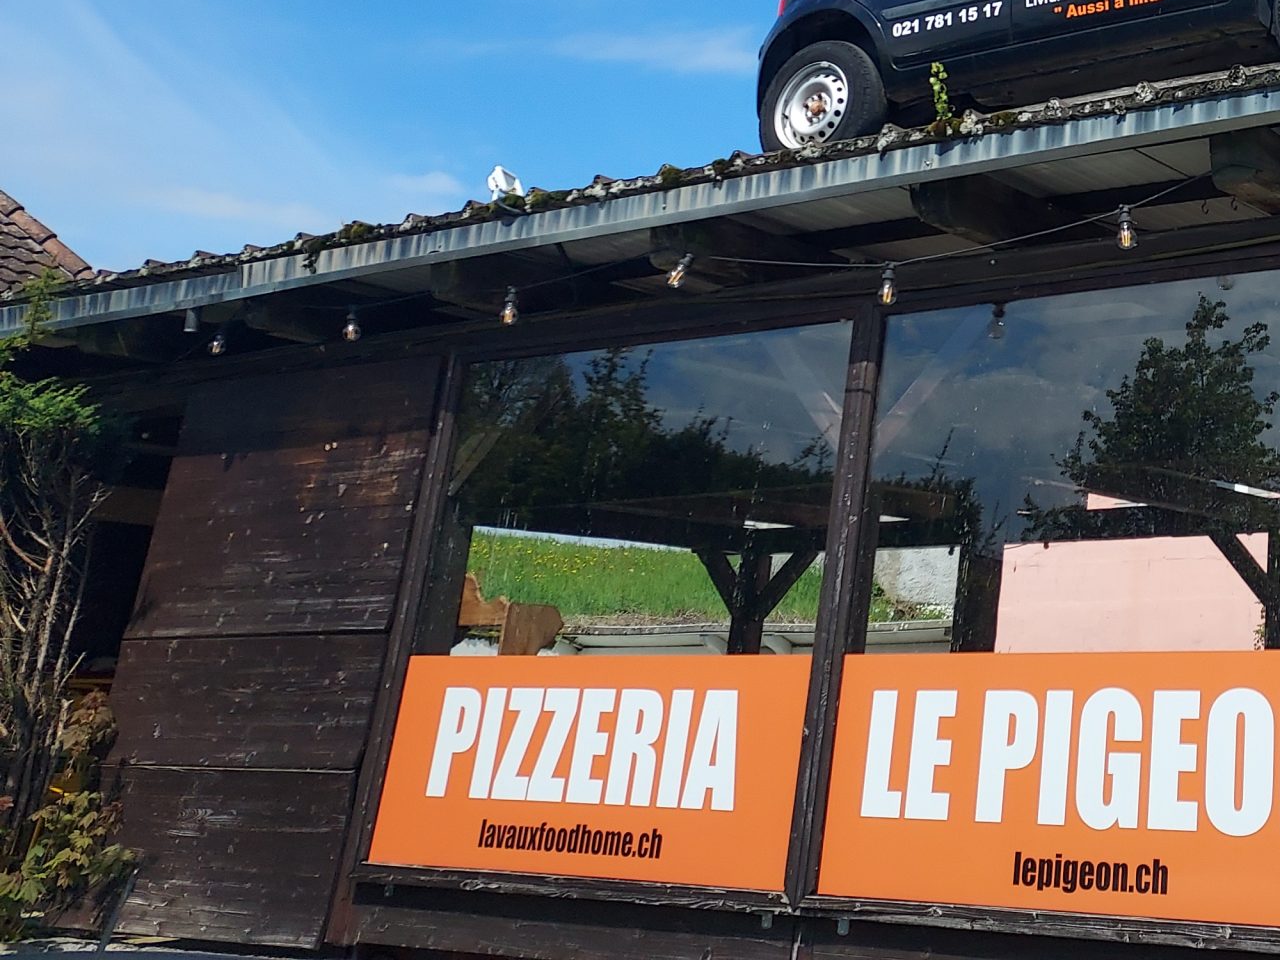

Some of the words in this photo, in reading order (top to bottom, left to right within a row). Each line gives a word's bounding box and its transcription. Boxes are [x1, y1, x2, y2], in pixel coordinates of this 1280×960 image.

[892, 18, 920, 38] 021
[925, 11, 953, 31] 781
[958, 6, 978, 24] 15
[983, 1, 1003, 19] 17
[425, 687, 739, 811] PIZZERIA
[860, 689, 958, 821] LE
[477, 819, 664, 859] lavauxfoodhome.ch
[1012, 850, 1169, 895] lepigeon.ch
